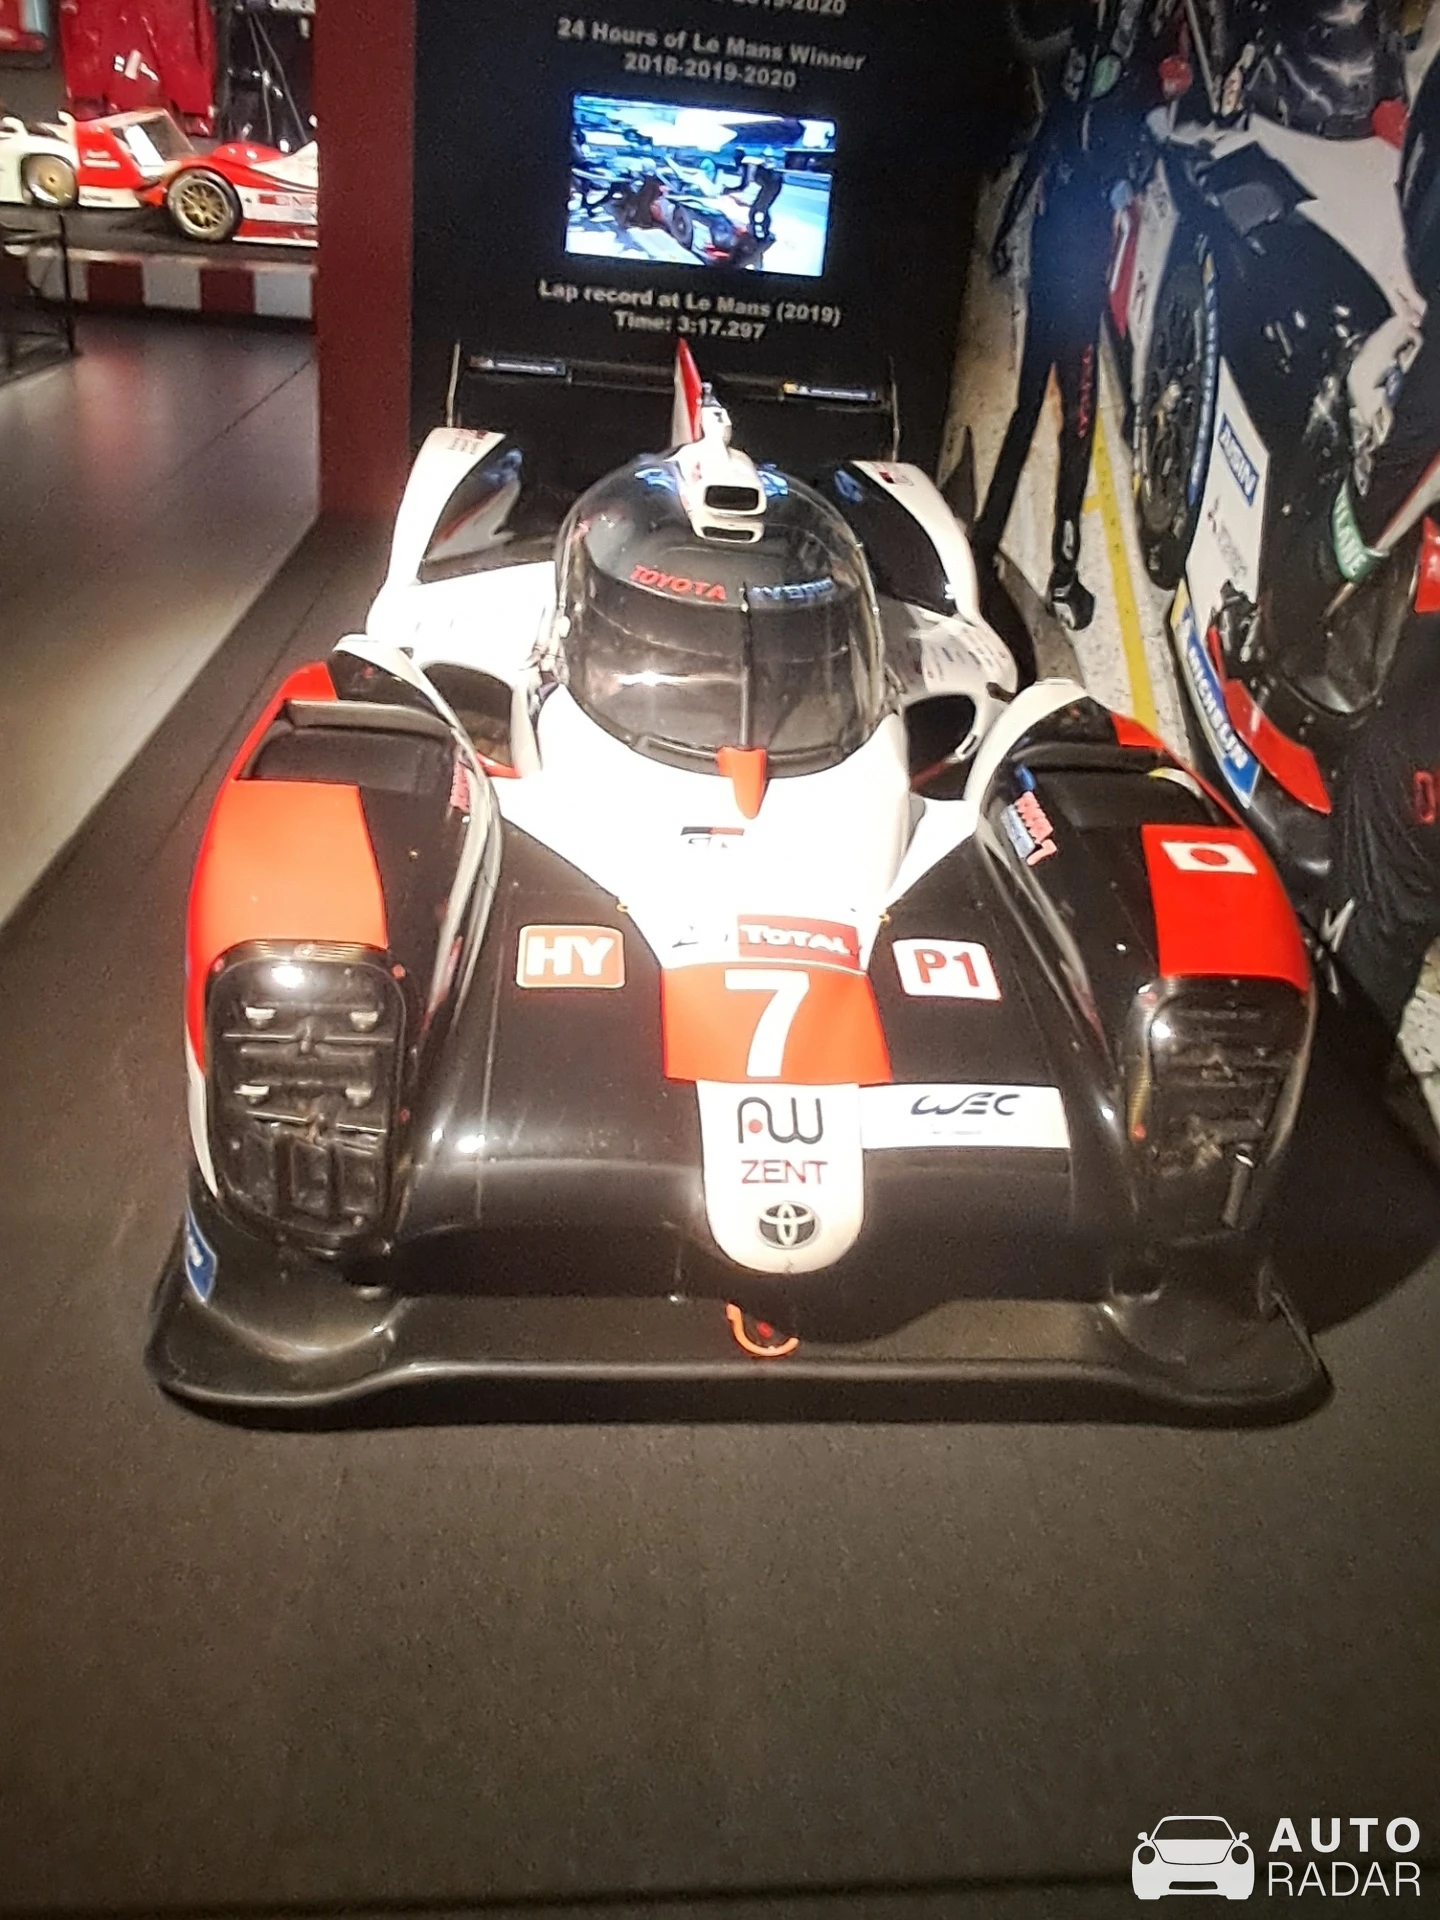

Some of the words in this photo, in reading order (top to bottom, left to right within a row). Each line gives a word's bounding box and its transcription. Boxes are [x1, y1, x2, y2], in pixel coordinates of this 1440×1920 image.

[557, 17, 585, 39] 24
[592, 21, 658, 47] Hours
[664, 30, 687, 49] of
[693, 33, 720, 53] Le
[726, 37, 784, 61] Mans
[789, 44, 867, 71] Winner
[538, 279, 578, 302] Lap
[583, 285, 654, 306] record
[657, 291, 680, 308] at
[685, 292, 711, 311] Le
[717, 296, 771, 318] Mans
[776, 301, 841, 328] (2019)
[613, 310, 672, 332] Time:
[677, 314, 766, 339] 3:17.297
[630, 564, 727, 600] TOYOTA
[525, 935, 615, 977] HY
[739, 924, 851, 955] TOTAL
[913, 948, 980, 987] P1
[724, 968, 811, 1077] 7
[910, 1092, 1021, 1116] WEC
[741, 1160, 828, 1185] ZENT
